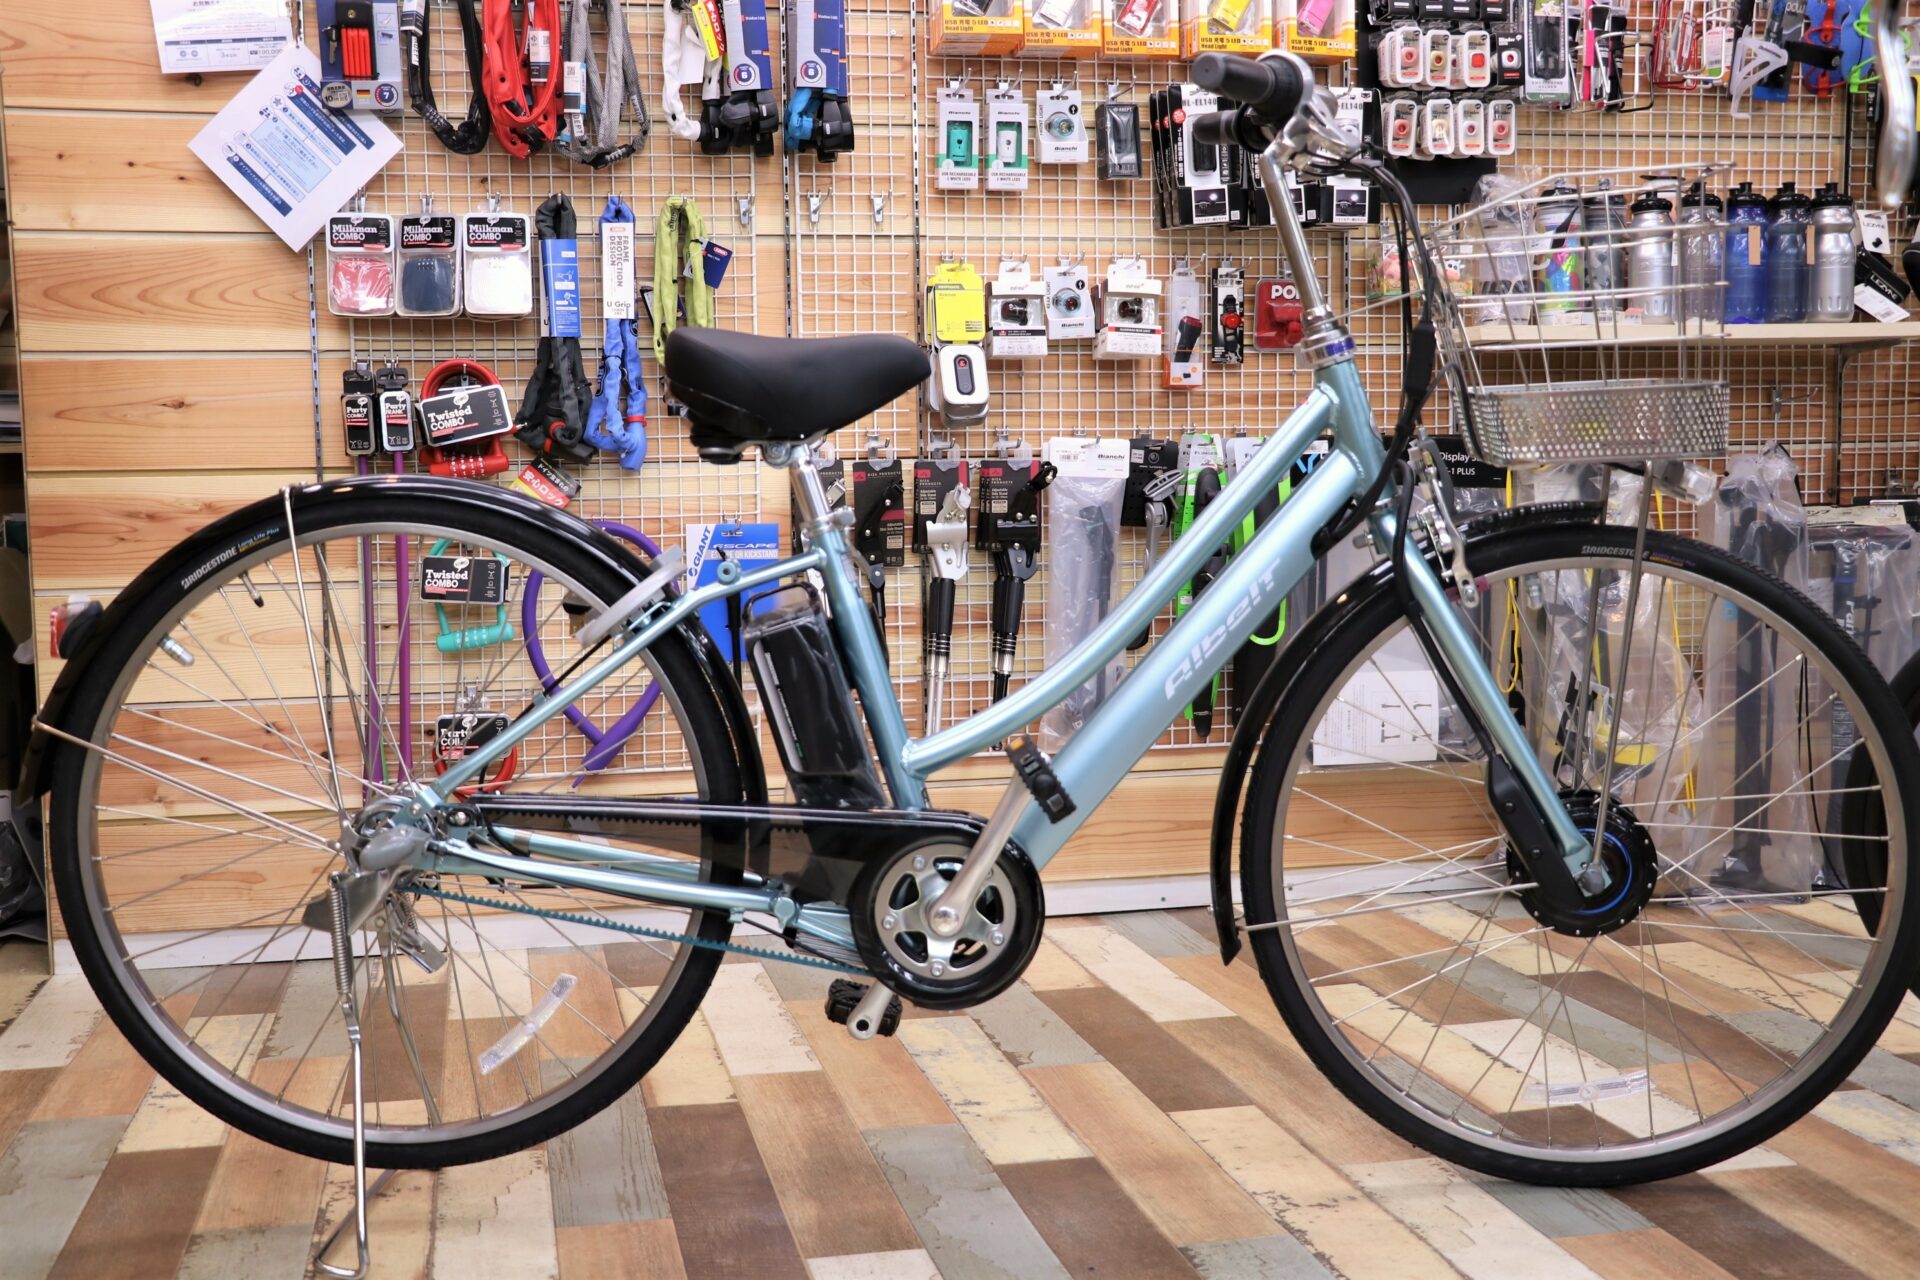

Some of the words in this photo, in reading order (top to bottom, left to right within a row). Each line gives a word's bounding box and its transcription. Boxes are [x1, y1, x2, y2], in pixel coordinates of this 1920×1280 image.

[332, 224, 377, 233] Milkman
[403, 225, 443, 234] Milkman
[469, 224, 514, 233] Milkman
[403, 233, 432, 241] COMBO
[469, 232, 502, 240] COMBO
[1870, 274, 1898, 300] LEZYNE
[428, 405, 472, 422] Twisted
[430, 417, 464, 431] COMBO
[1440, 452, 1470, 463] Display
[538, 463, 569, 491] ドイツ生まれの
[523, 470, 564, 506] 安心ロック
[238, 538, 254, 548] Long
[254, 533, 265, 541] Life
[267, 528, 279, 536] Plus
[693, 526, 710, 567] GIANT
[1582, 546, 1649, 559] BRIDGESTOE
[181, 546, 237, 589] BRIDGESTONE
[425, 570, 468, 580] Twisted
[425, 579, 458, 588] COMBO
